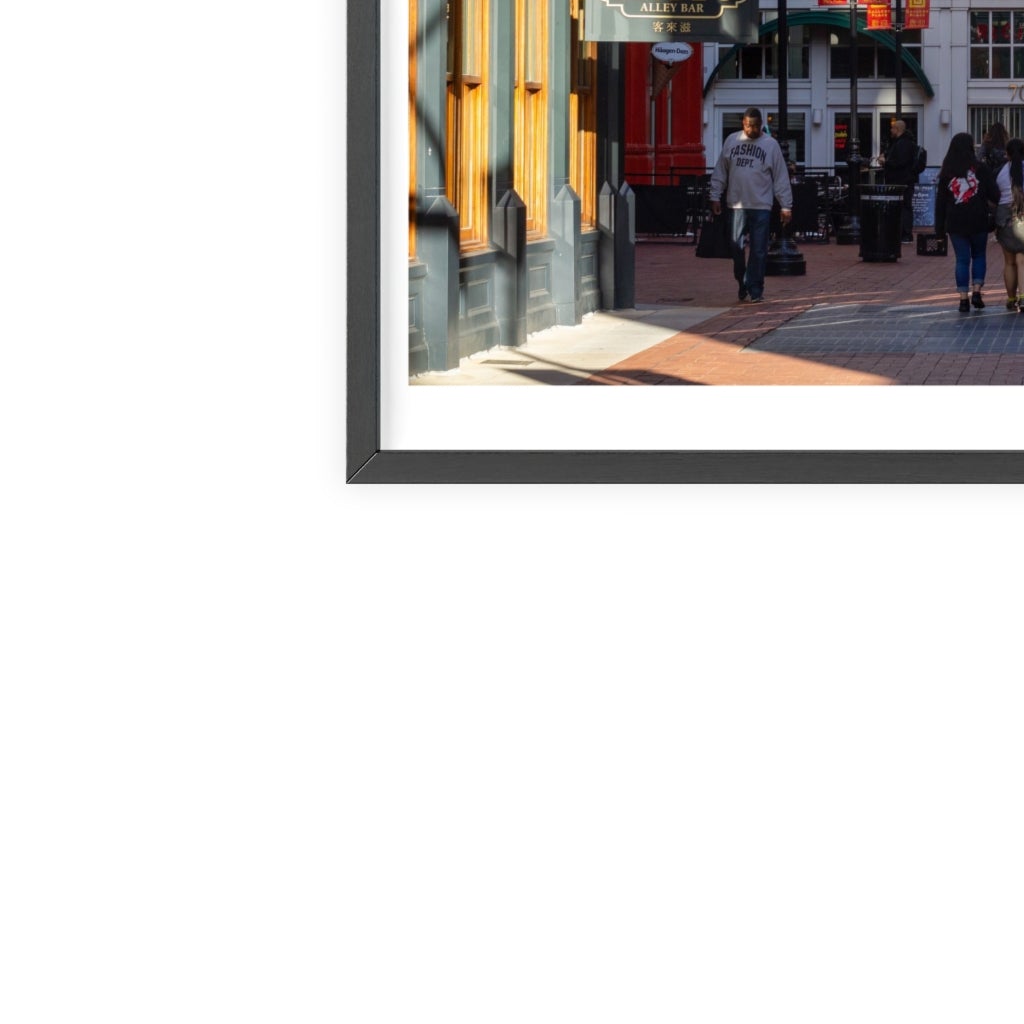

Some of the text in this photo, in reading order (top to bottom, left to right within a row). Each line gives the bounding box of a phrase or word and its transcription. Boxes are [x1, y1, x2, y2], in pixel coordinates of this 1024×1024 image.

[639, 3, 705, 14] ALLEY BAR
[729, 143, 767, 165] FASHION
